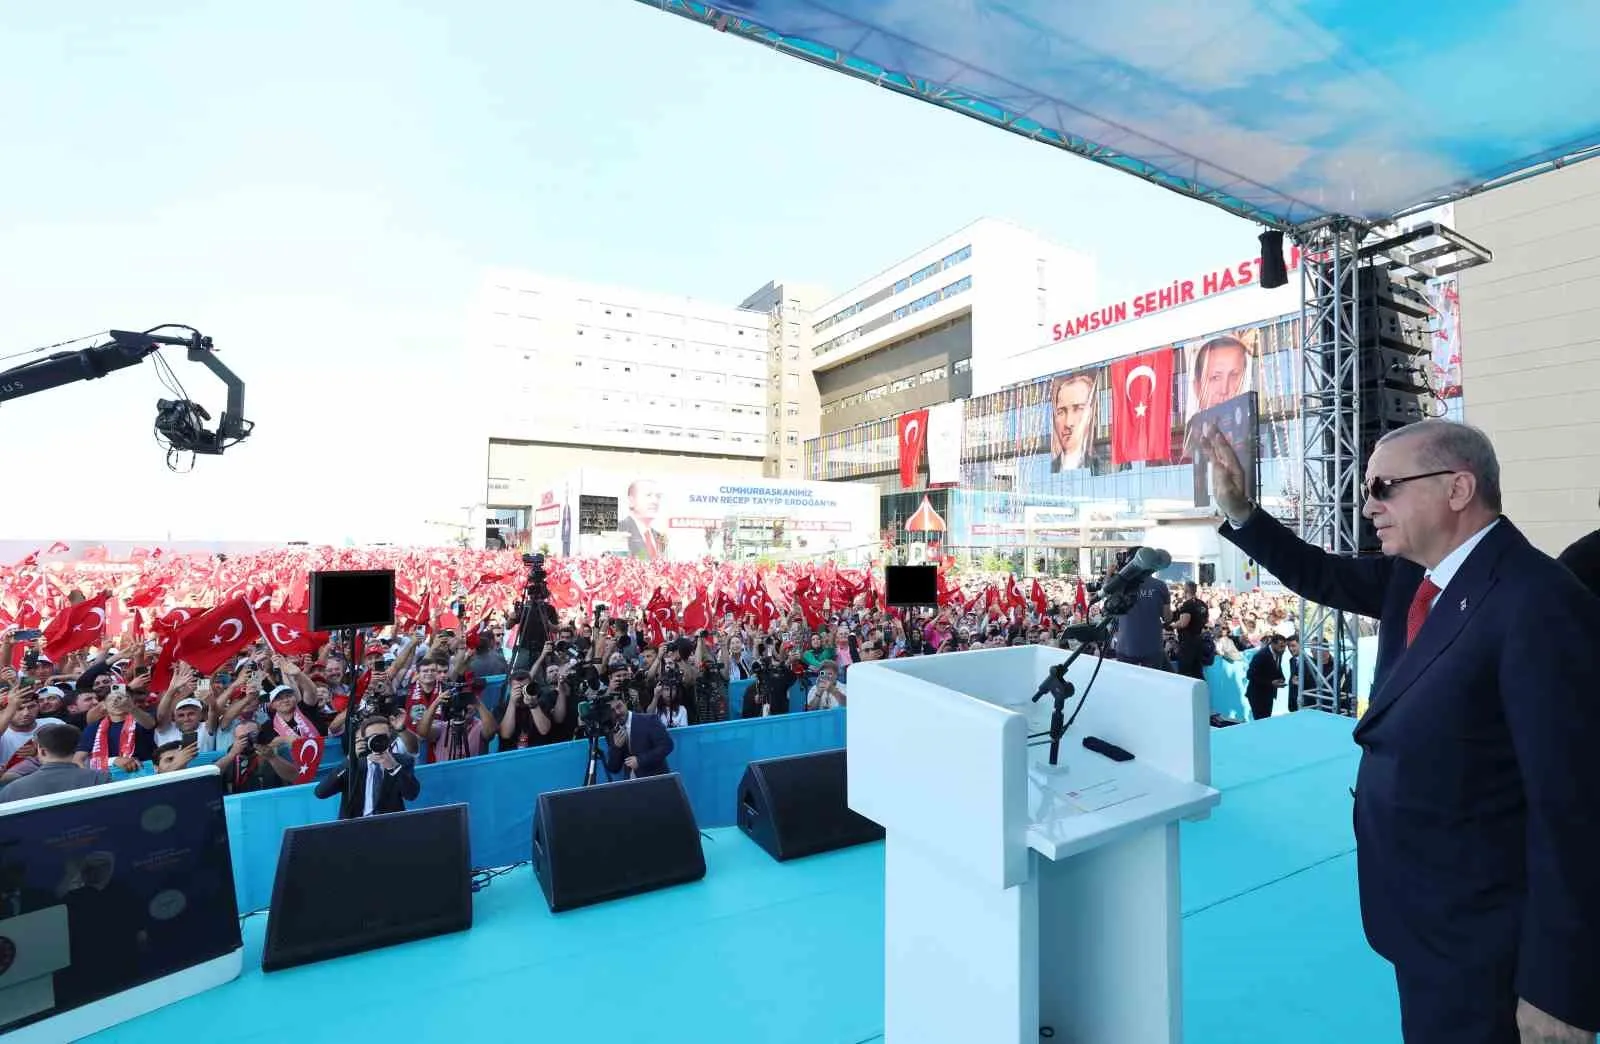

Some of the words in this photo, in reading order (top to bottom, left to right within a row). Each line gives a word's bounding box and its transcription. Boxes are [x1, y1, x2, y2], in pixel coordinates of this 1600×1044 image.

[1052, 301, 1127, 341] SAMSUN
[1133, 279, 1195, 318] ŞEHİR
[720, 495, 750, 505] RECEP
